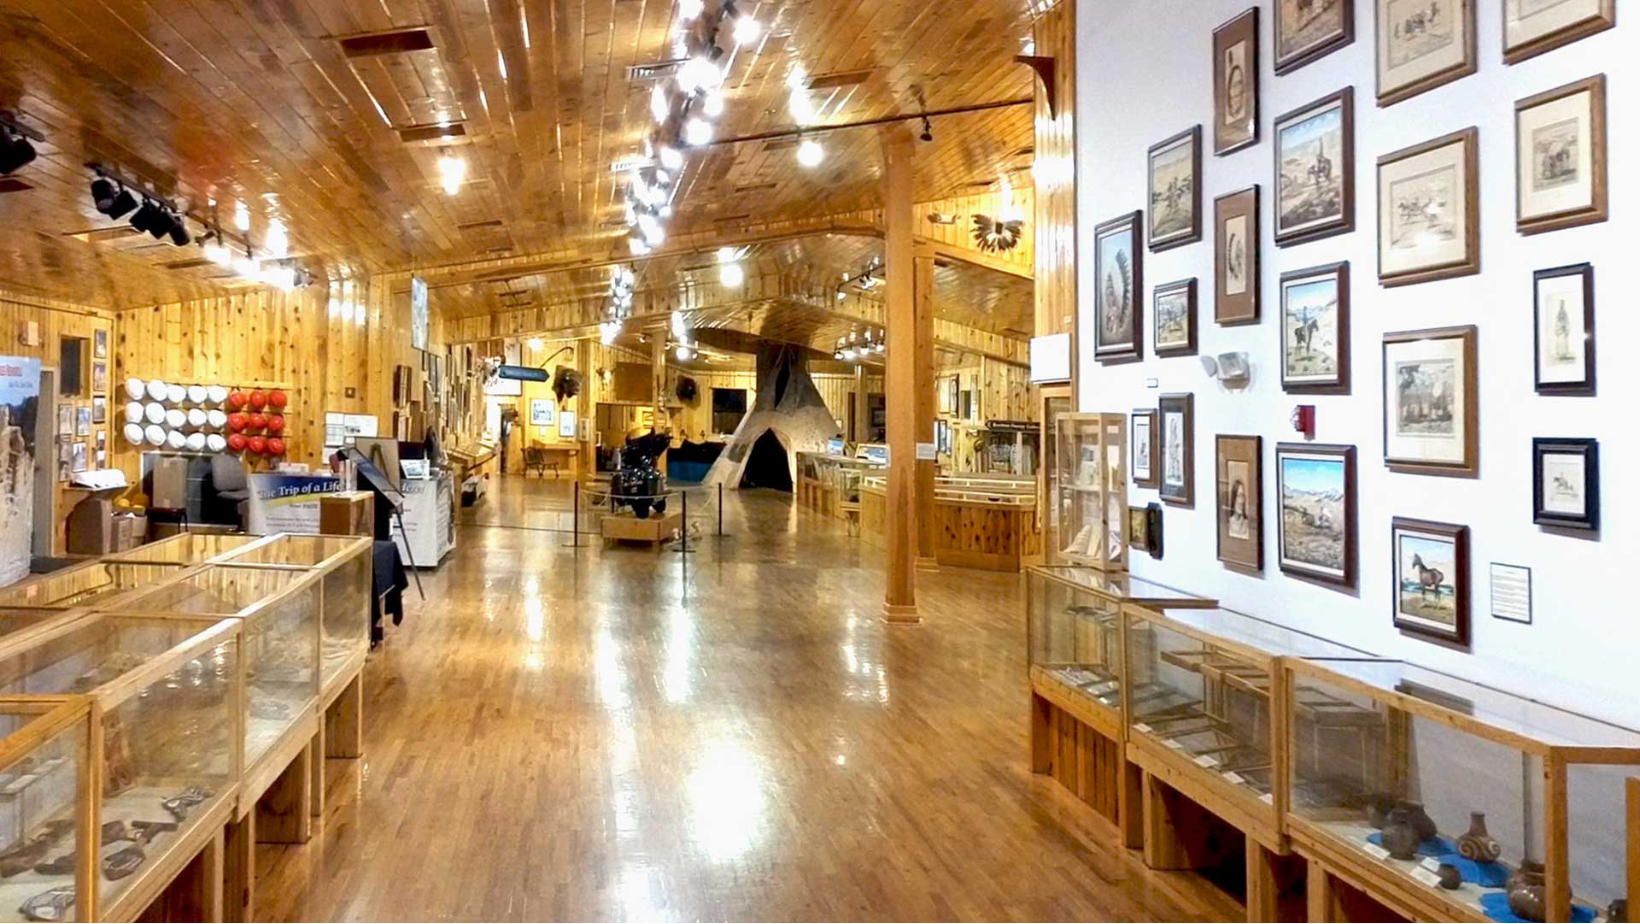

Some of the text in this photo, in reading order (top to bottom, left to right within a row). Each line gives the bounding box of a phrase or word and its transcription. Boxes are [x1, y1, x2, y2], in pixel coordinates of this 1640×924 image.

[278, 486, 300, 497] Trip
[301, 482, 313, 494] of
[313, 484, 320, 492] a
